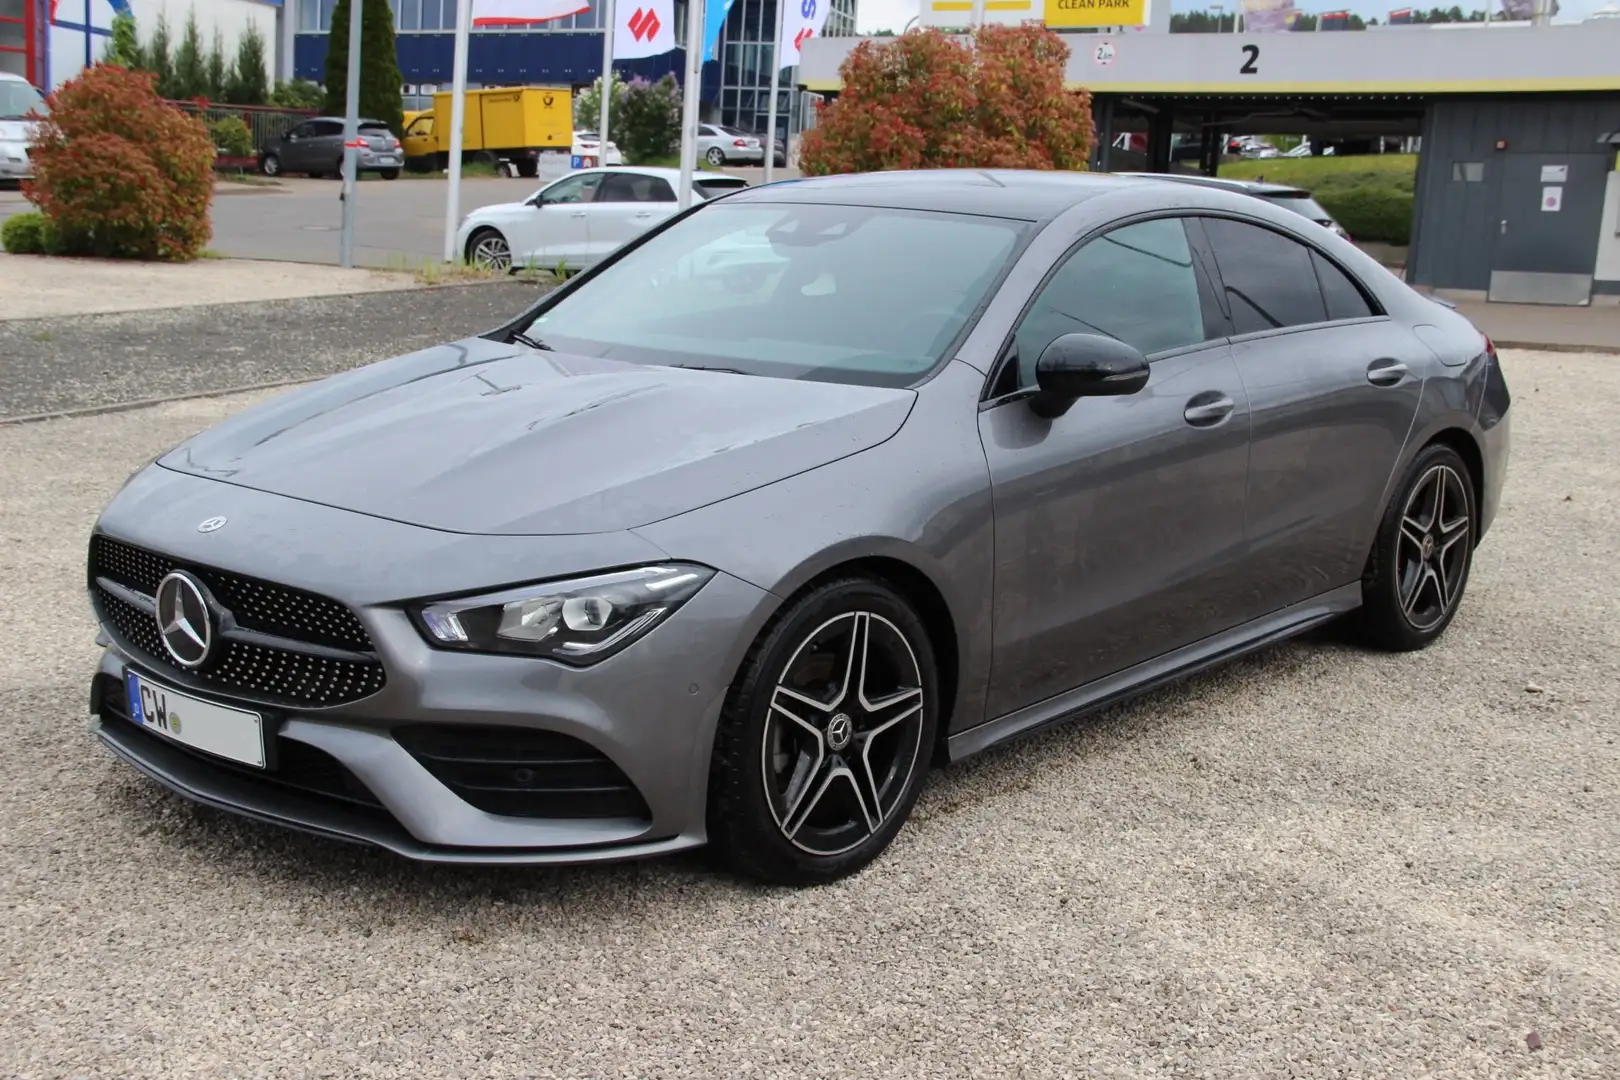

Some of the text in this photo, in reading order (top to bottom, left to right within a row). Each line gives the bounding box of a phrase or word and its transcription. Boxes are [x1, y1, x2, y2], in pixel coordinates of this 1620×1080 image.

[1058, 0, 1129, 9] CLEAN PARK
[1240, 44, 1259, 74] 2
[140, 684, 167, 730] CW
